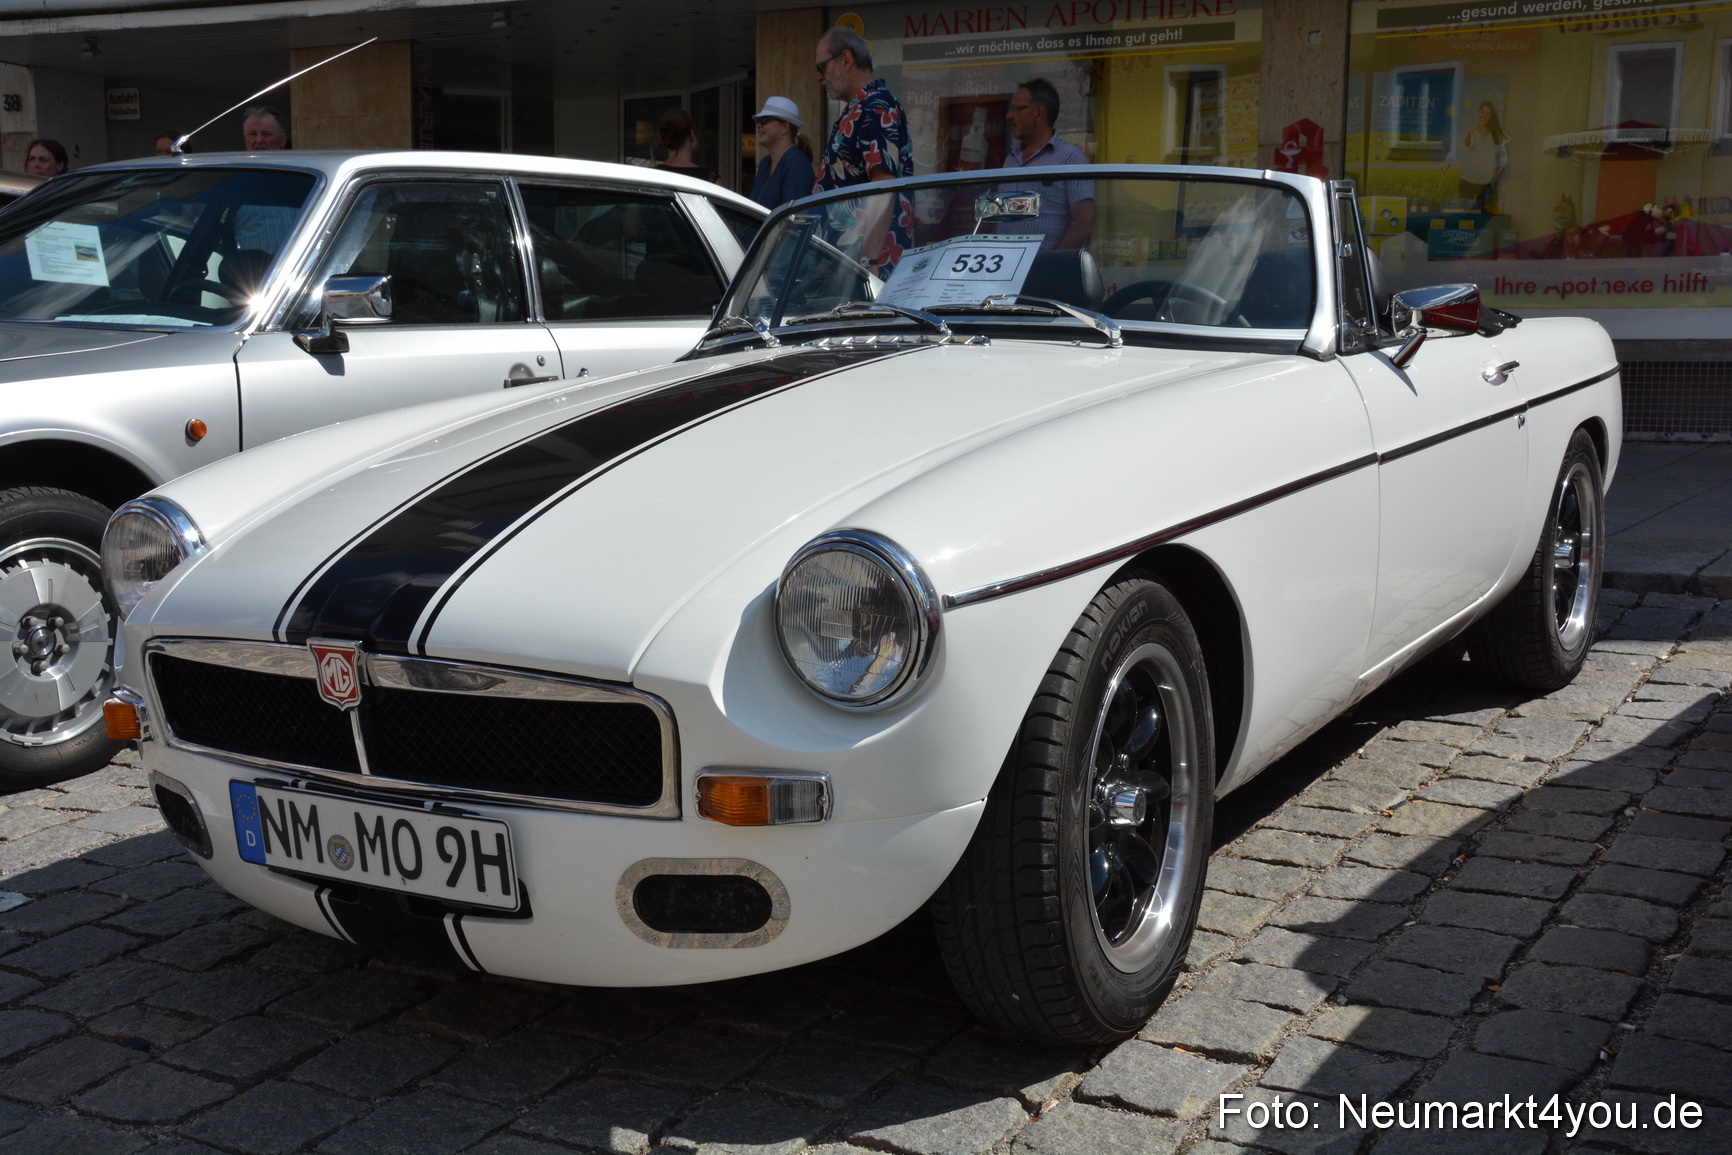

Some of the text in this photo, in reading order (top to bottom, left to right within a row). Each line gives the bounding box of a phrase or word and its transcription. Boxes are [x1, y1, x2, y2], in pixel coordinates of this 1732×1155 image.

[1522, 0, 1587, 14] werden,
[904, 0, 1238, 38] MARIEN APOTHEKE
[978, 40, 1033, 54] möchten,
[1037, 37, 1064, 49] dass
[1068, 38, 1082, 47] es
[1085, 34, 1121, 46] Ihnen
[1125, 32, 1146, 47] gut
[1150, 28, 1182, 44] geht!
[3, 94, 21, 111] 38
[109, 92, 138, 104] Ausfahrt
[109, 107, 138, 116] freihalten
[951, 253, 1004, 274] 533
[1494, 276, 1537, 296] Ihre
[1662, 272, 1708, 293] hilft
[325, 657, 351, 694] MG
[245, 830, 257, 847] D
[257, 795, 324, 863] NM
[354, 811, 423, 880] MO
[435, 825, 512, 896] 9H
